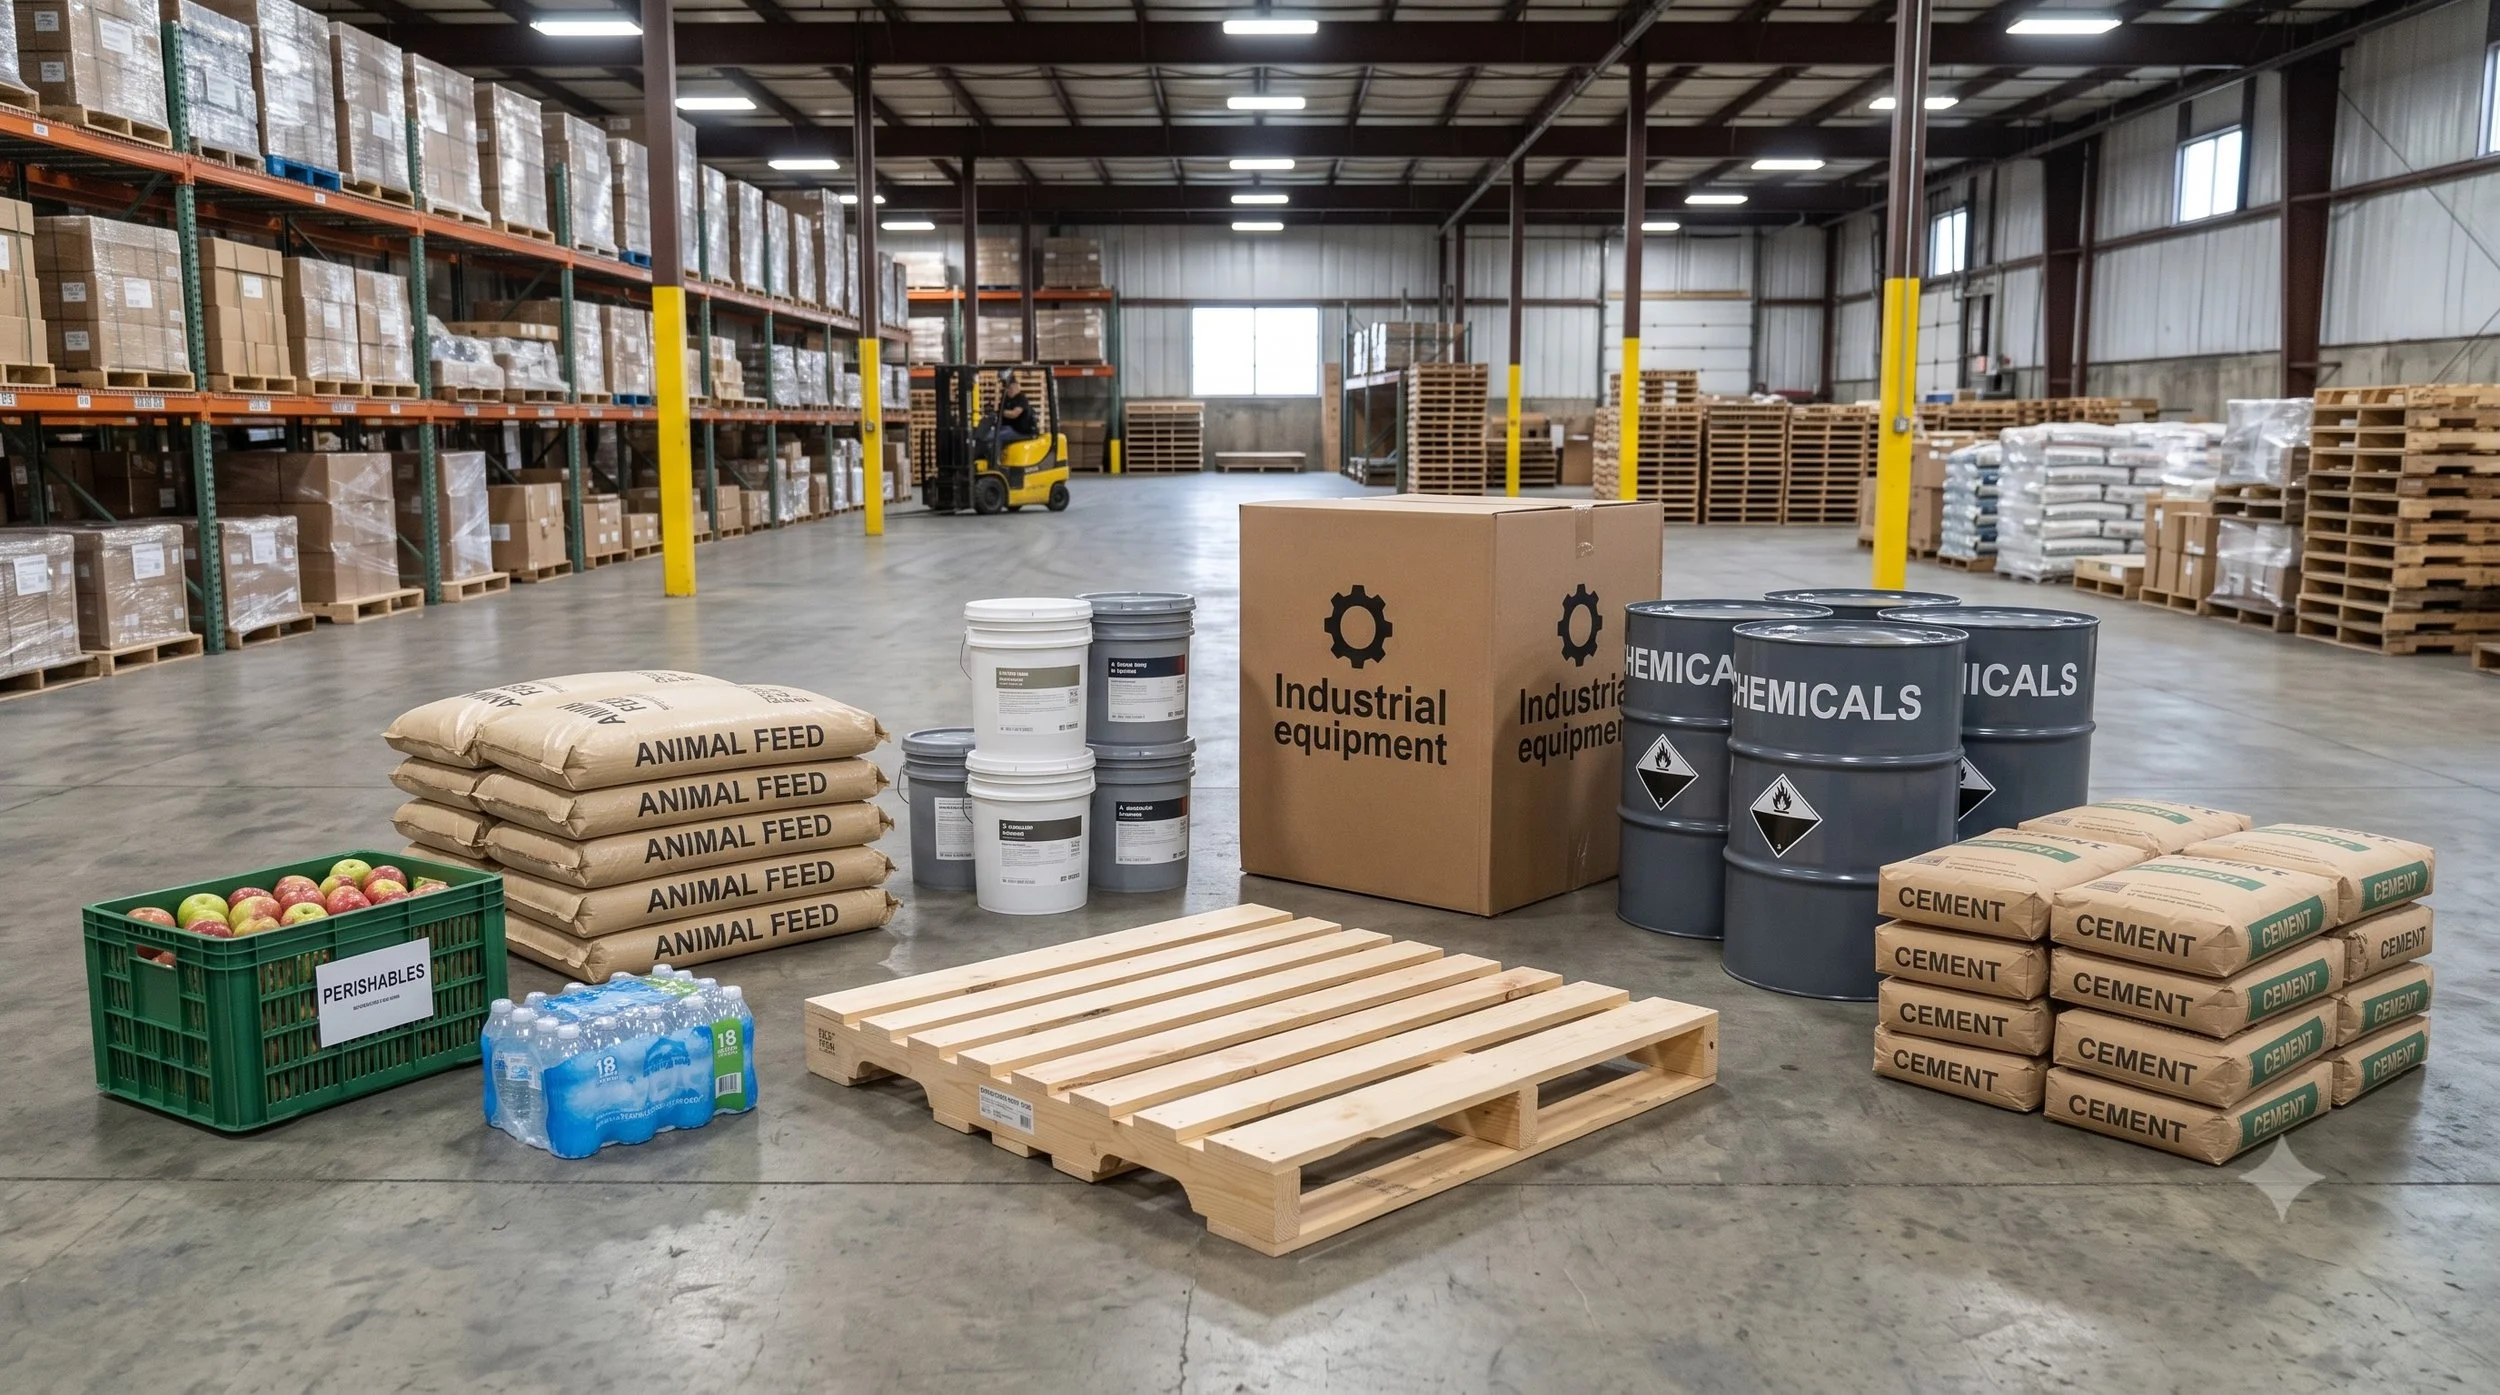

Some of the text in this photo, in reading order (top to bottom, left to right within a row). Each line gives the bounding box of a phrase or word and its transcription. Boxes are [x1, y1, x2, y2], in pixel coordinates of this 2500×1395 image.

[1625, 644, 1734, 686] HEMICA
[1963, 662, 2078, 697] ICALS
[1275, 673, 1446, 726] Industrial
[1520, 673, 1625, 725] Industria
[635, 724, 824, 768] ANIMAL FEED
[1274, 719, 1447, 765] equipment
[1518, 719, 1623, 767] equipme
[637, 772, 826, 818] ANIMAL FEED
[644, 814, 832, 864] ANIMAL FEED
[647, 860, 835, 914] ANIMAL FEED
[1898, 887, 2006, 923] CEMENT
[2373, 870, 2418, 902] CEMENT
[653, 904, 839, 961] ANIMAL FEED
[2076, 914, 2197, 958] CEMENT
[2262, 908, 2312, 949] CEMENT
[2380, 926, 2426, 961] CEMENT
[324, 963, 425, 1004] PERISHABLES
[1894, 947, 2002, 983] CEMENT
[2073, 972, 2194, 1018] CEMENT
[2263, 970, 2317, 1010] CEMENT
[2374, 989, 2420, 1023] CEMENT
[717, 1029, 737, 1048] 18
[1899, 1002, 2009, 1038] CEMENT
[596, 1056, 616, 1076] 18
[1893, 1049, 1999, 1093] CEMENT
[2077, 1037, 2197, 1086] CEMENT
[2264, 1029, 2313, 1075] CEMENT
[2372, 1041, 2417, 1080] CEMENT
[2068, 1094, 2188, 1144] CEMENT
[2253, 1093, 2307, 1137] CEMENT
